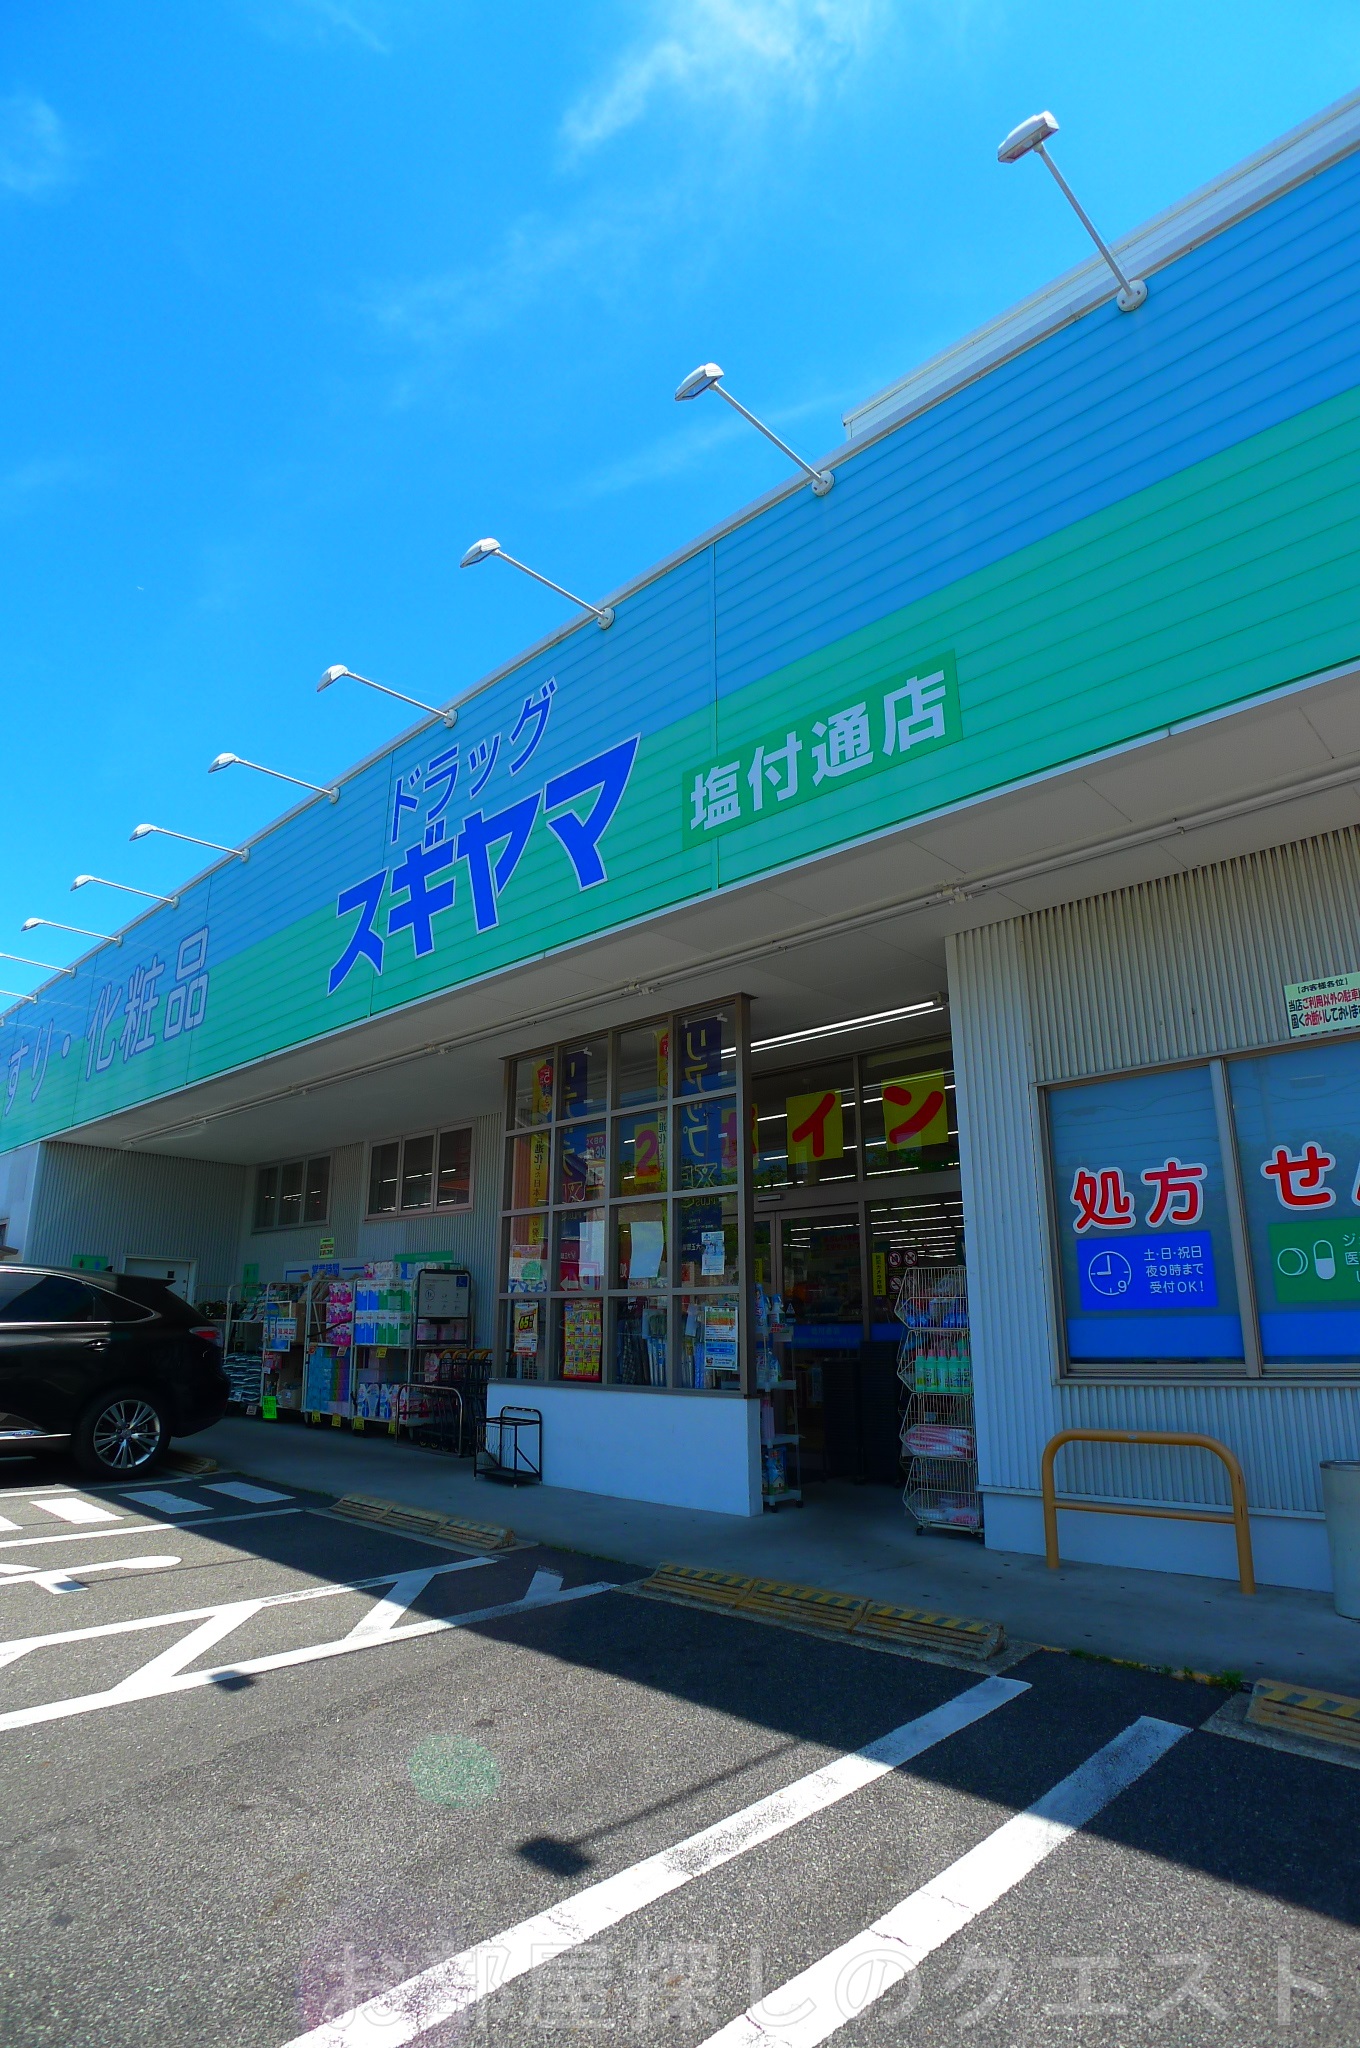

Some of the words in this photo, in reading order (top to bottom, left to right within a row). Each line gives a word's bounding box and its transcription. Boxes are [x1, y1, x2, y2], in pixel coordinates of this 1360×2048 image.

[390, 676, 557, 845] ドラッグ
[690, 670, 946, 831] 塩付通店
[327, 732, 641, 997] スギヤマ
[1288, 988, 1360, 1012] 当店ご利用以外の駐車
[1290, 1004, 1360, 1029] 固くお断りしておりま
[752, 1086, 944, 1158] イン
[1070, 1141, 1360, 1233] 処方せ
[1342, 1232, 1360, 1247] ジ
[1344, 1251, 1360, 1265] 医
[1145, 1263, 1204, 1278] 夜9時まで
